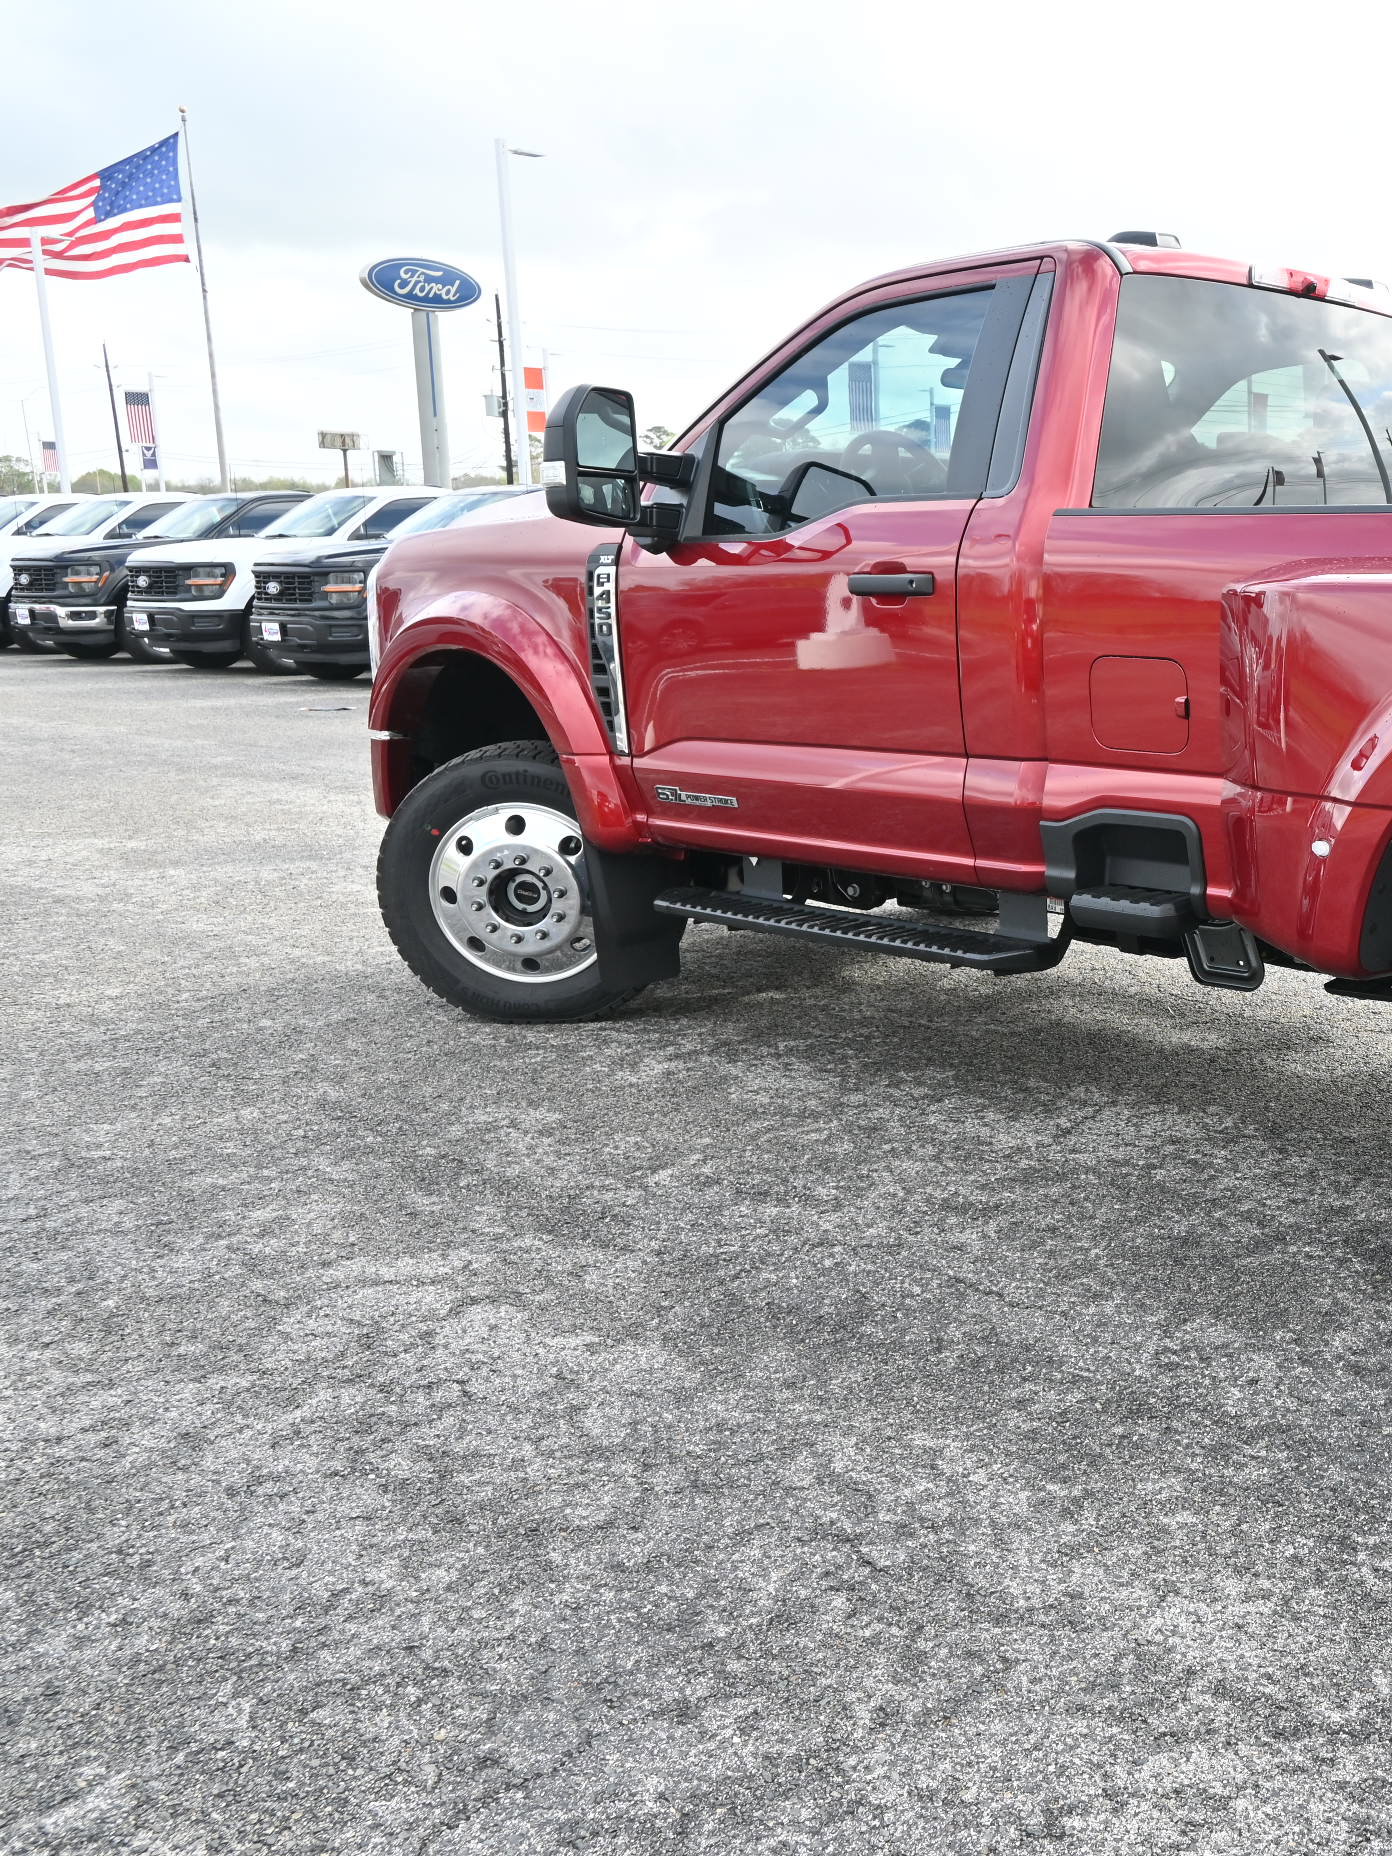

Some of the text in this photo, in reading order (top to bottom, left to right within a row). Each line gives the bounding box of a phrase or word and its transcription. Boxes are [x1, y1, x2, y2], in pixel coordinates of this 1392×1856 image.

[394, 265, 460, 300] Ford
[599, 555, 614, 563] XLT
[596, 573, 613, 637] F450
[481, 769, 569, 796] Continen
